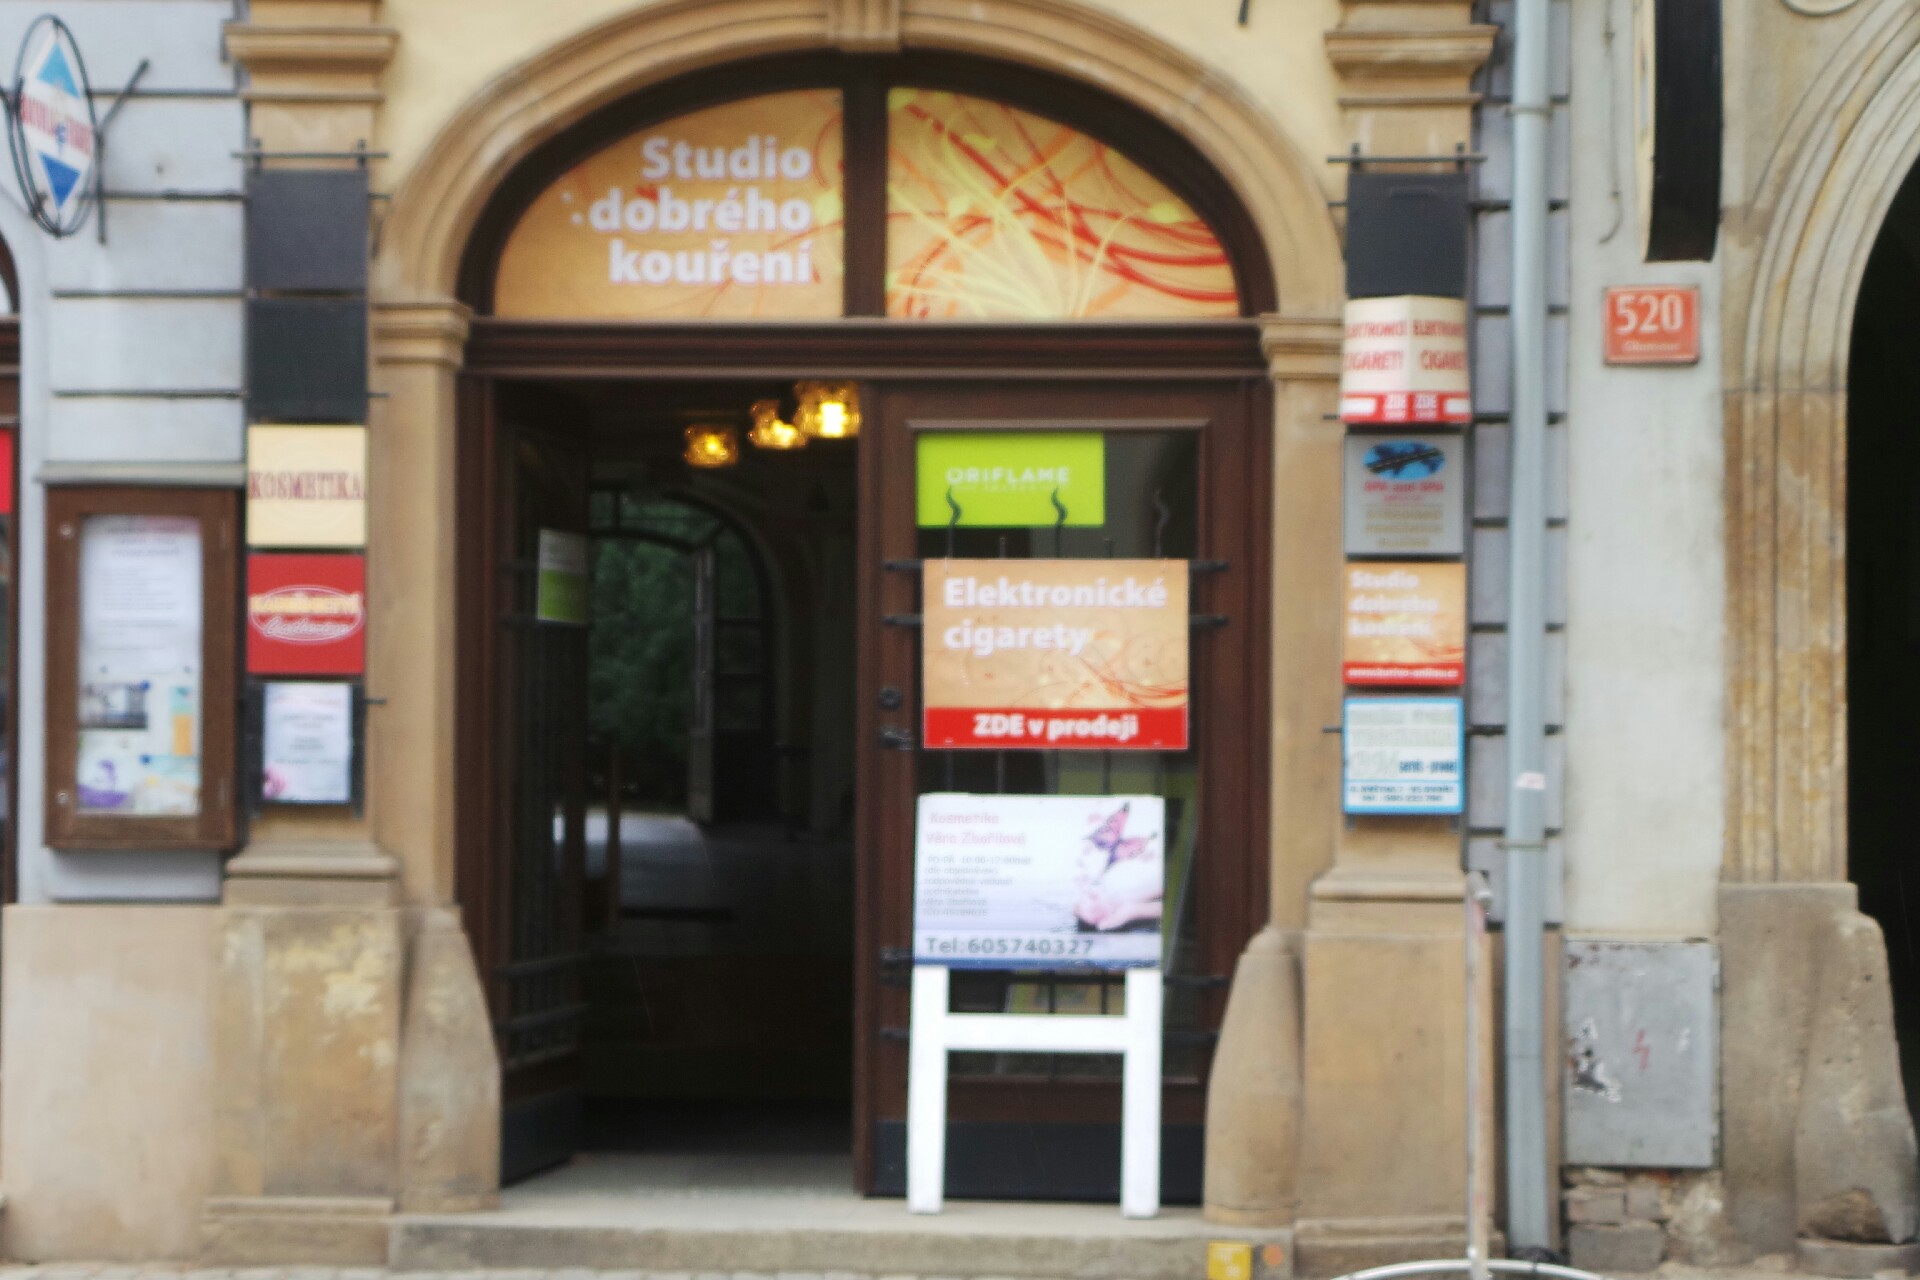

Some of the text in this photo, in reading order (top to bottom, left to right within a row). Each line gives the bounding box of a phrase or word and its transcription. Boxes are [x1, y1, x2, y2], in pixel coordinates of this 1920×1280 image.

[641, 135, 812, 180] Studio
[588, 185, 812, 231] dobrého
[608, 240, 812, 283] kouření
[1615, 294, 1683, 334] 520
[248, 472, 364, 499] KOSMETIKA
[946, 467, 1070, 485] ORIFLAME
[944, 576, 1168, 608] Elektronické
[944, 618, 1090, 656] cigarety
[974, 713, 1138, 742] ZDE v prodeji
[929, 812, 1000, 824] Kosmetika
[926, 937, 1095, 955] Tel:605740327
